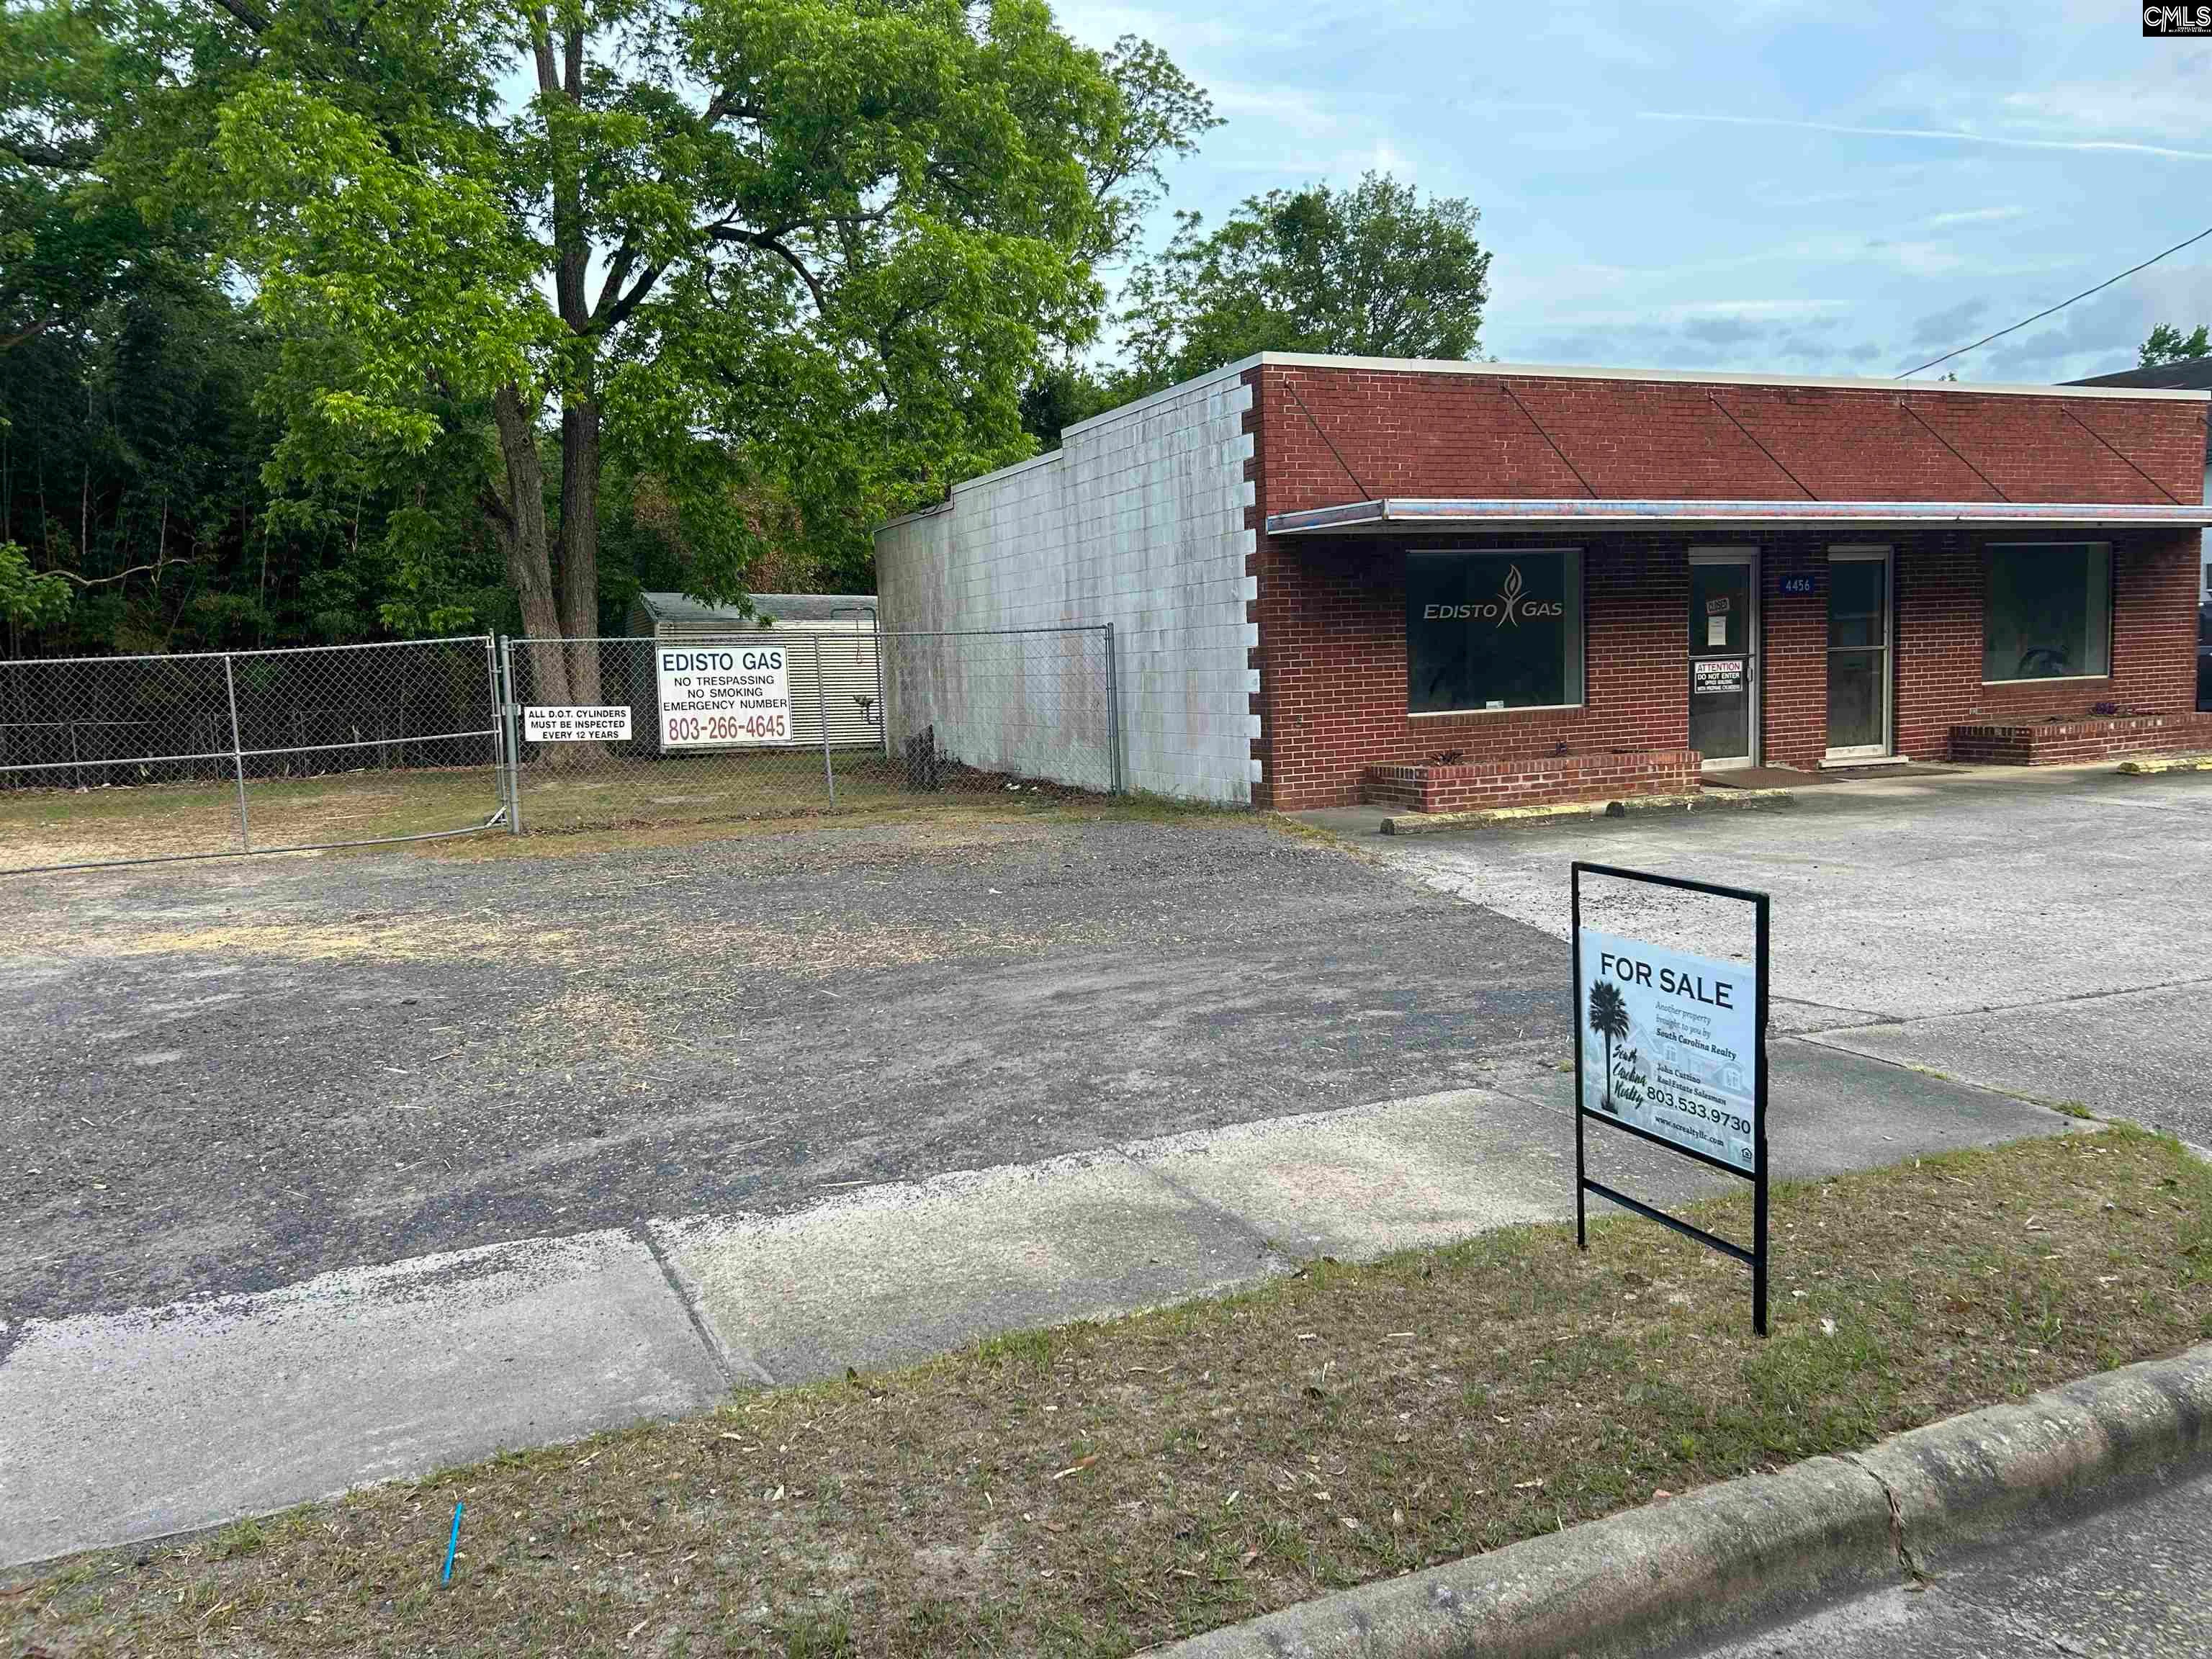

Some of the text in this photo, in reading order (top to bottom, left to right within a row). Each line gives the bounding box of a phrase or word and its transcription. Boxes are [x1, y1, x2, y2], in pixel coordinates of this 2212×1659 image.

[1785, 579, 1809, 592] 4456
[1424, 601, 1563, 619] EDISTO GAS
[662, 652, 783, 672] EDISTO GAS
[1697, 662, 1740, 673] ATTENTION
[674, 675, 775, 686] NO TRESPASSING
[688, 687, 763, 698] NO SMOKING
[663, 698, 788, 711] EMERGENCY NUMBER
[669, 714, 786, 741] 803-266-4645
[1601, 952, 1733, 1010] FOR SALE
[1655, 1001, 1712, 1026] Another property
[1689, 1027, 1701, 1035] you
[1702, 1028, 1711, 1040] by
[1655, 1028, 1737, 1061] South Carolina Realty
[1657, 1062, 1673, 1075] John
[1657, 1075, 1727, 1106] Real Estate Salesman
[1647, 1086, 1751, 1134] 803.533.9730
